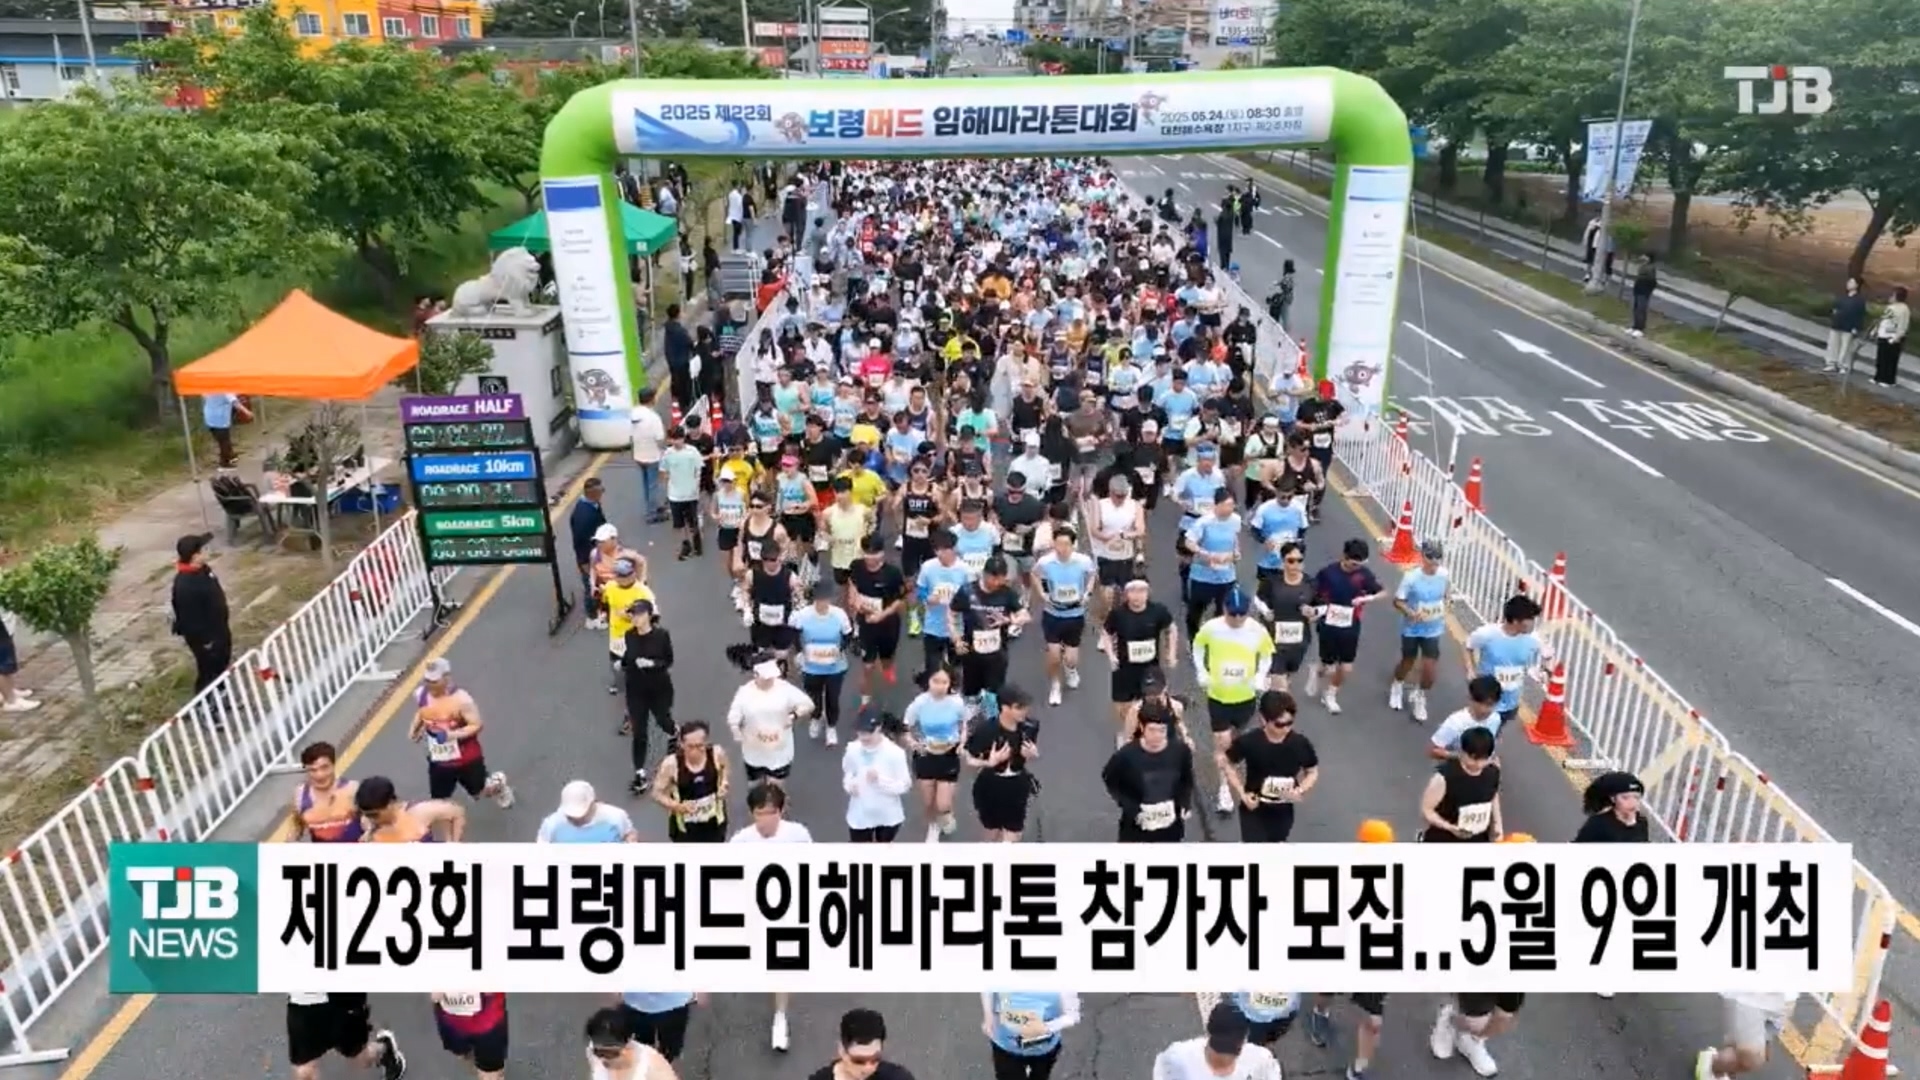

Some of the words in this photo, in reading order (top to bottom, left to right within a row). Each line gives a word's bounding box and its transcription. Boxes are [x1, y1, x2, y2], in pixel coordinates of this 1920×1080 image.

[660, 104, 710, 120] 2025
[714, 104, 772, 122] 제22회
[808, 108, 924, 139] 보령머드
[933, 103, 1139, 136] 임해마라톤대회
[1246, 107, 1281, 119] 08:30
[411, 404, 469, 416] ROADRACE
[474, 399, 513, 414] HALF
[424, 463, 480, 475] ROADRACE
[485, 459, 525, 473] 10km
[436, 518, 495, 530] ROADRACE
[501, 515, 535, 528] 5km
